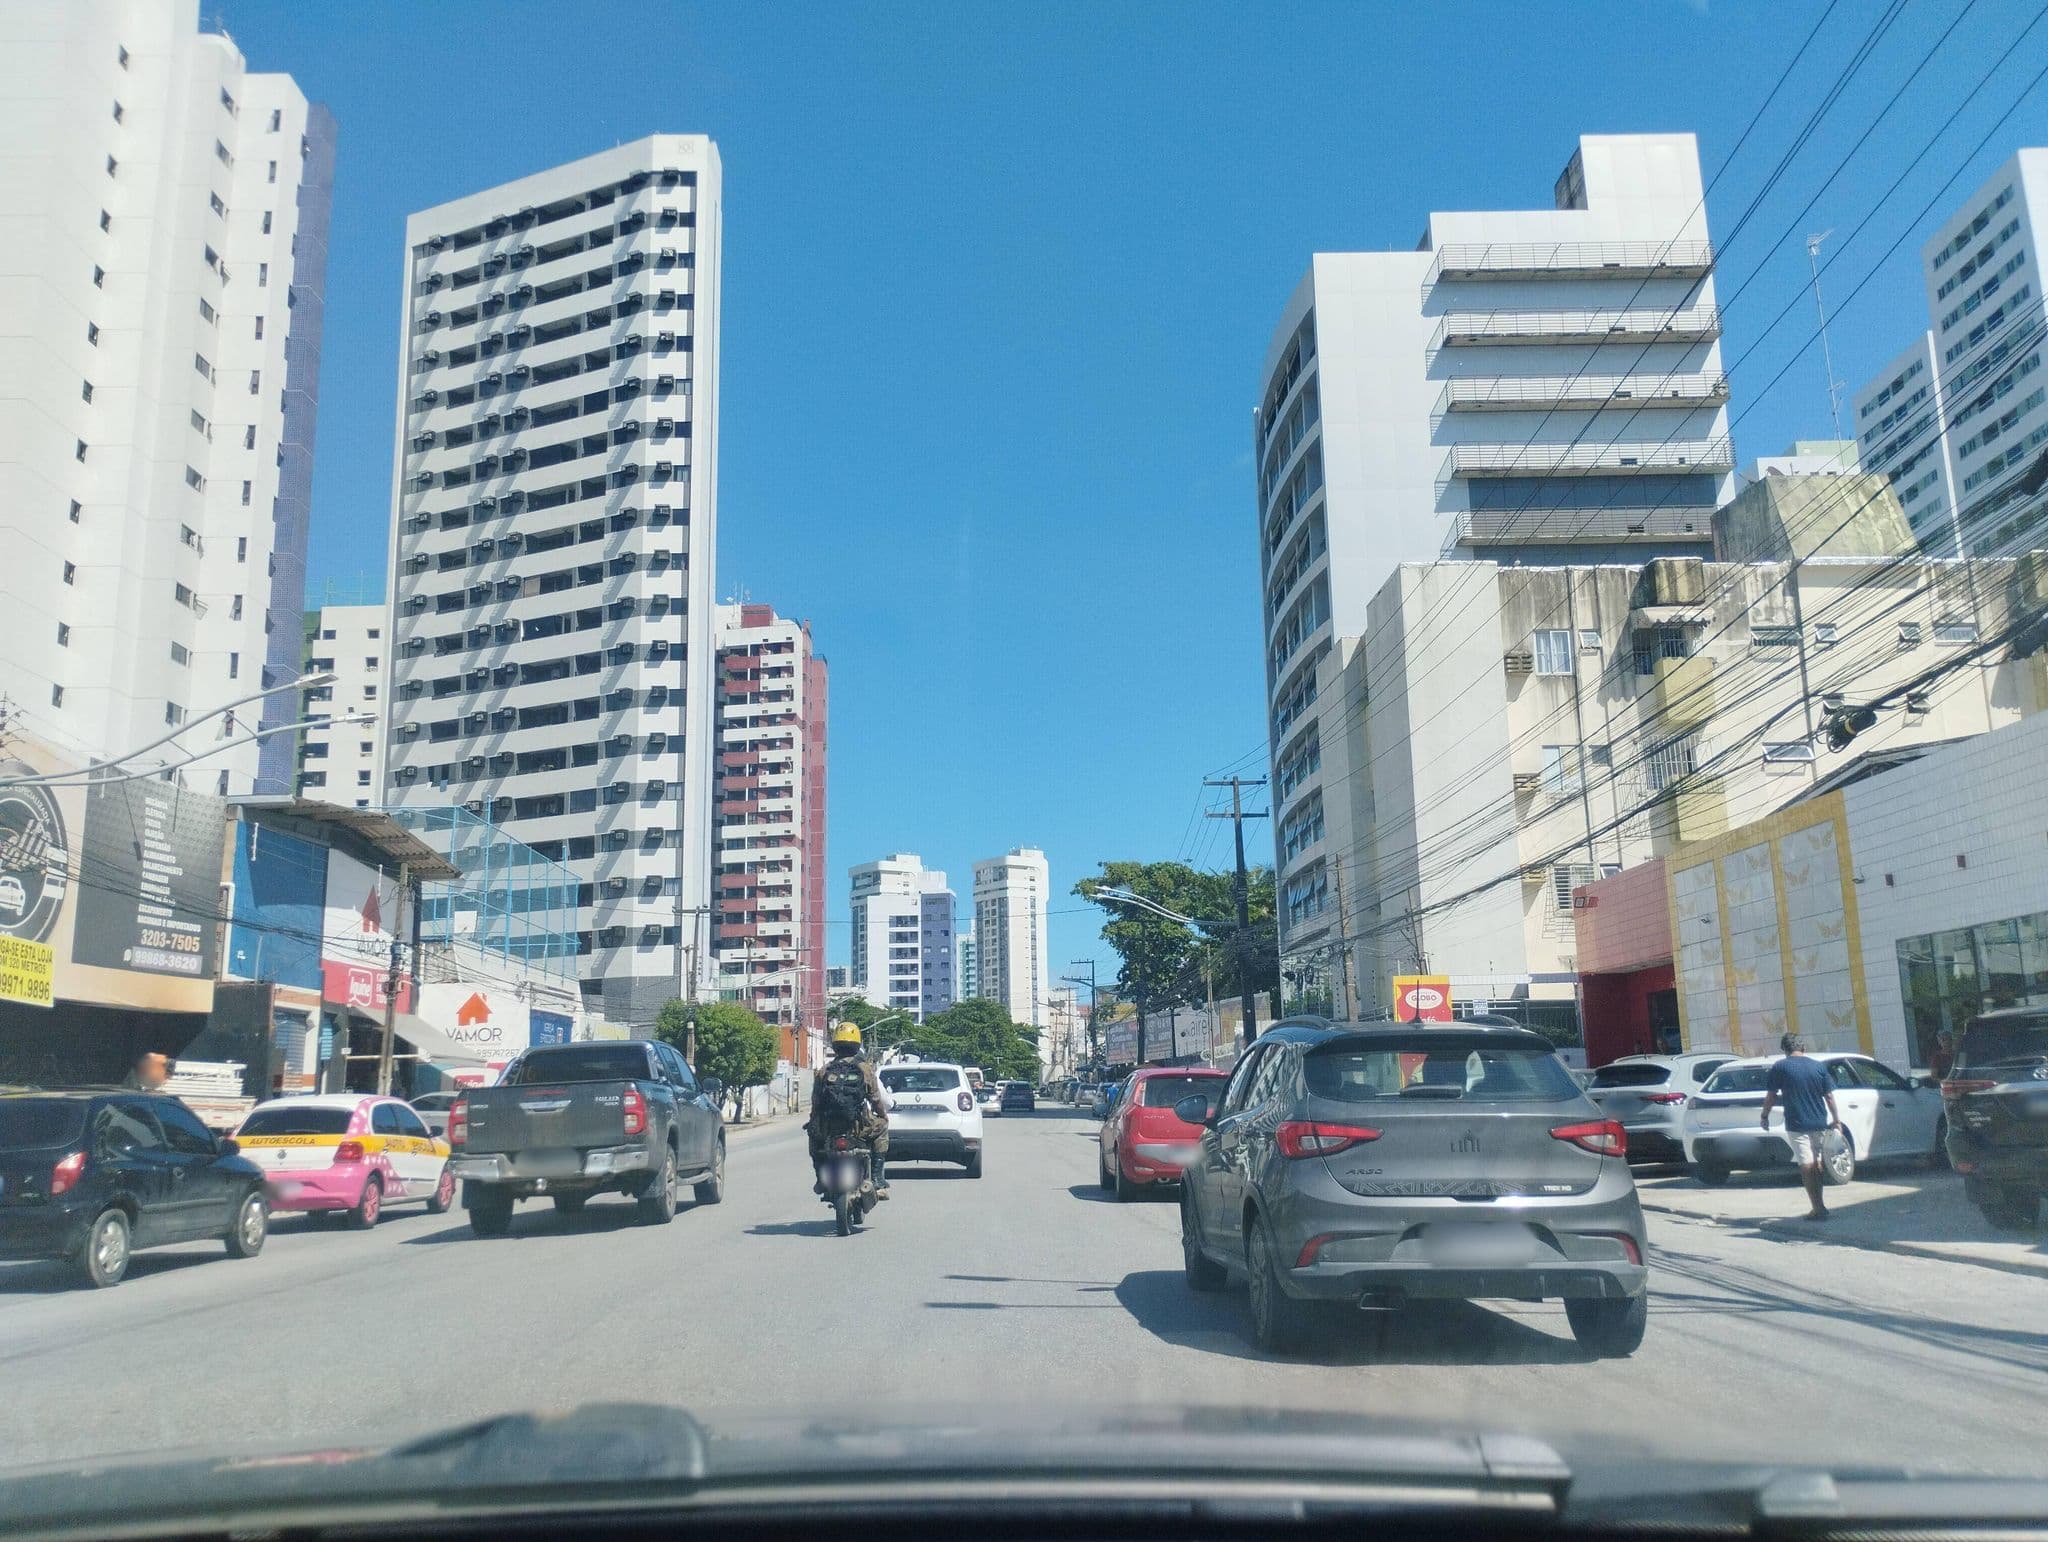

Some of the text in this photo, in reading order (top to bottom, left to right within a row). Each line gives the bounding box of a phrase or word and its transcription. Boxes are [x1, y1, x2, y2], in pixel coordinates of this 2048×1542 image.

[141, 928, 200, 953] 3203-7505
[0, 939, 19, 957] GA-SE
[20, 943, 37, 962] ESTA
[21, 959, 47, 975] METROS
[0, 972, 50, 1000] 9971.9896
[1411, 991, 1438, 1002] GOBO
[446, 1027, 503, 1042] VAMOR
[249, 1136, 316, 1146] AUTOESCOLA
[1345, 1167, 1384, 1176] ARGO
